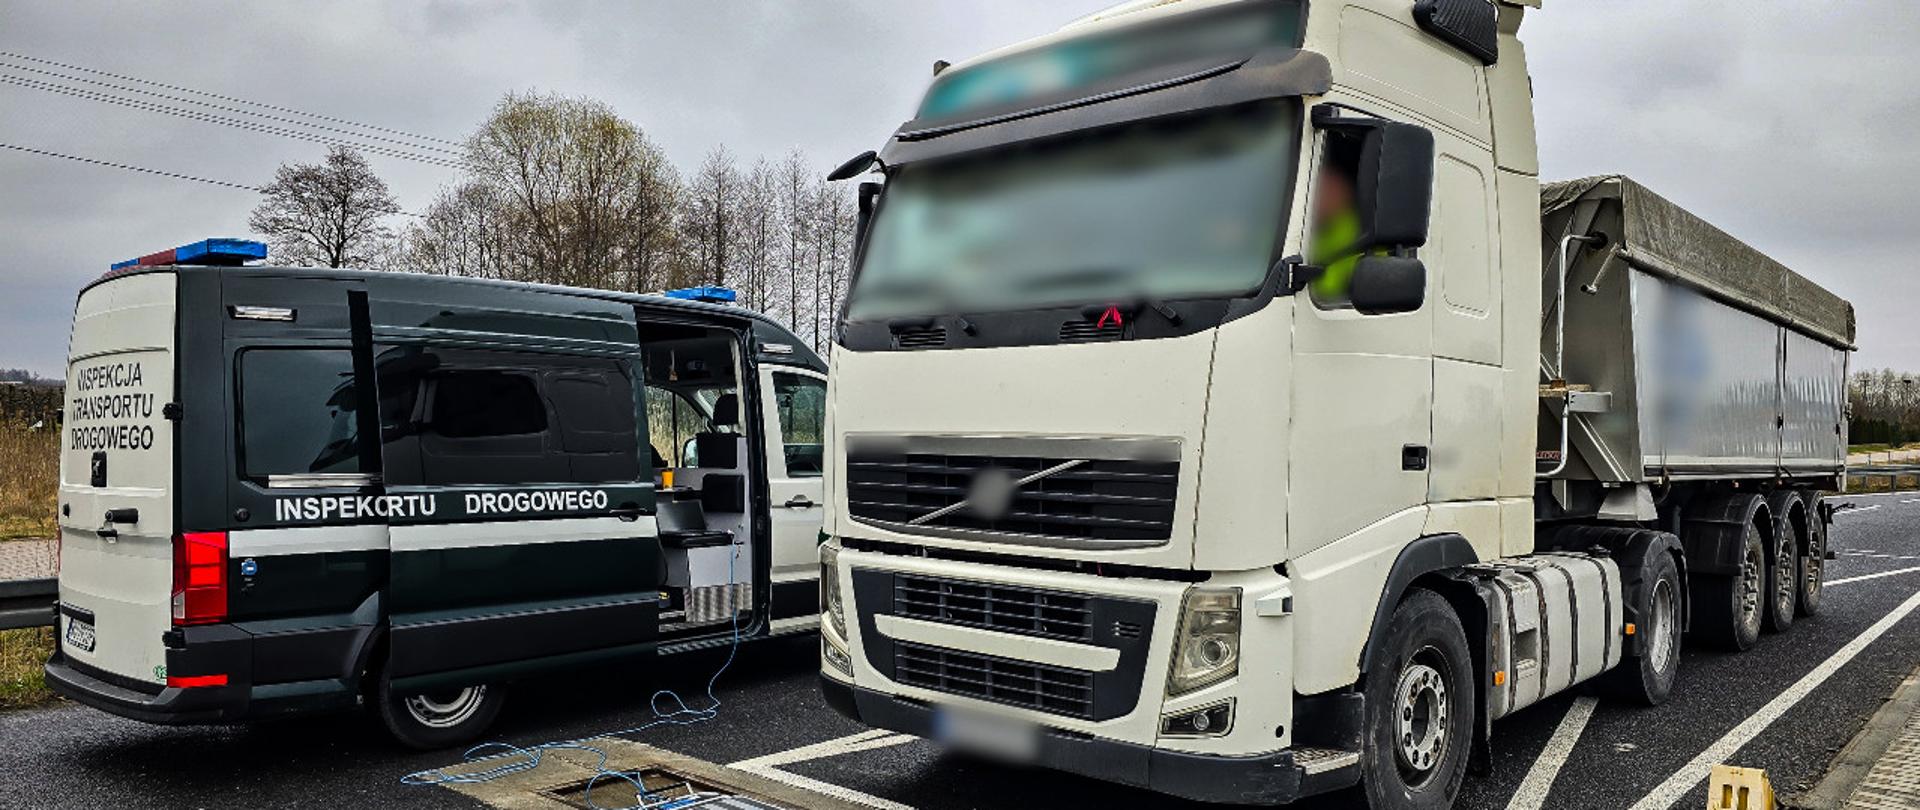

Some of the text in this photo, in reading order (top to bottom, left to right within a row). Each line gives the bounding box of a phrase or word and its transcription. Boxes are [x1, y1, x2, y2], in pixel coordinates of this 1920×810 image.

[78, 362, 142, 391] INSPEKCJA
[73, 393, 153, 420] TRANSPORTU
[72, 425, 153, 449] DROGOWEGO
[465, 490, 608, 514] DROGOWEGO
